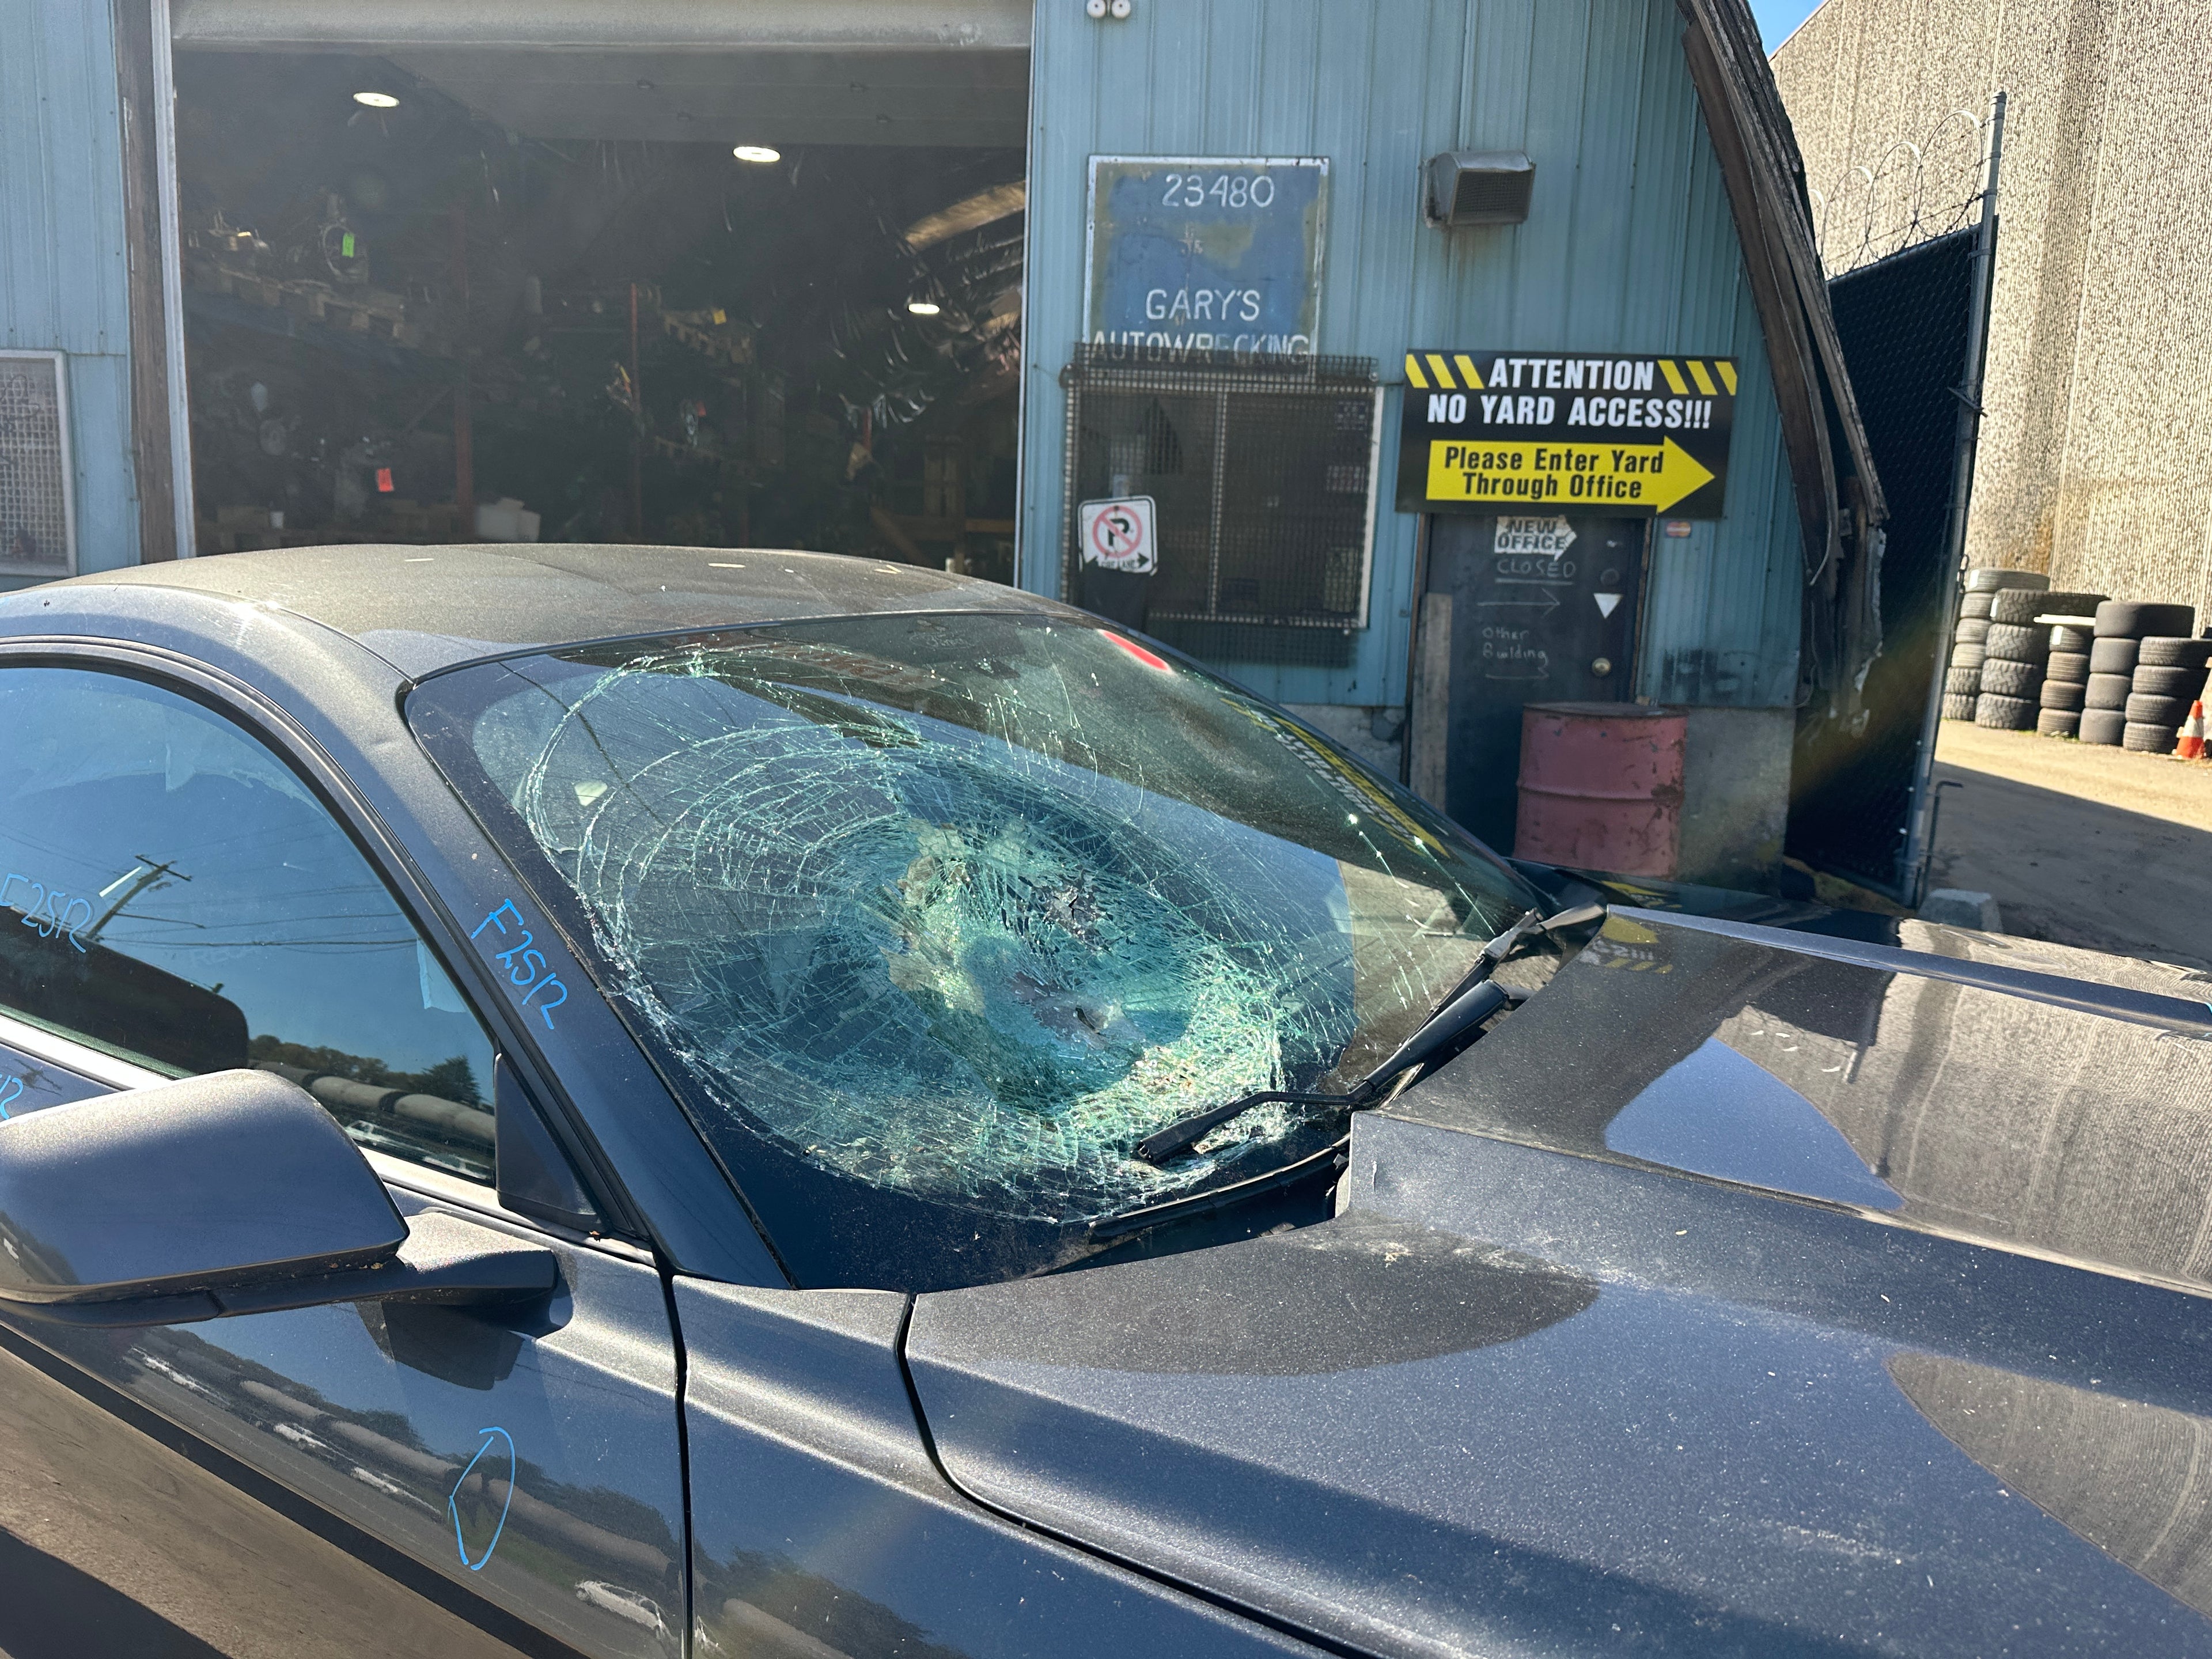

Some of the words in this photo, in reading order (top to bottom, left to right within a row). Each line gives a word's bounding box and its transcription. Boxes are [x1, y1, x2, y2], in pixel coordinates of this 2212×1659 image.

[1162, 174, 1275, 207] 23480
[1146, 289, 1260, 321] GARY'S
[1488, 358, 1655, 391] ATTENTION
[1427, 393, 1467, 423] NO
[1480, 395, 1555, 425] YARD
[1567, 396, 1712, 429] ACCESS!!!
[1445, 447, 1522, 471] Please
[1535, 448, 1599, 472] Enter
[1611, 450, 1664, 474] Yard
[1463, 473, 1556, 501] Through
[1570, 475, 1642, 499] Office
[1506, 518, 1556, 533] NEW
[1498, 533, 1566, 550] OFFICE
